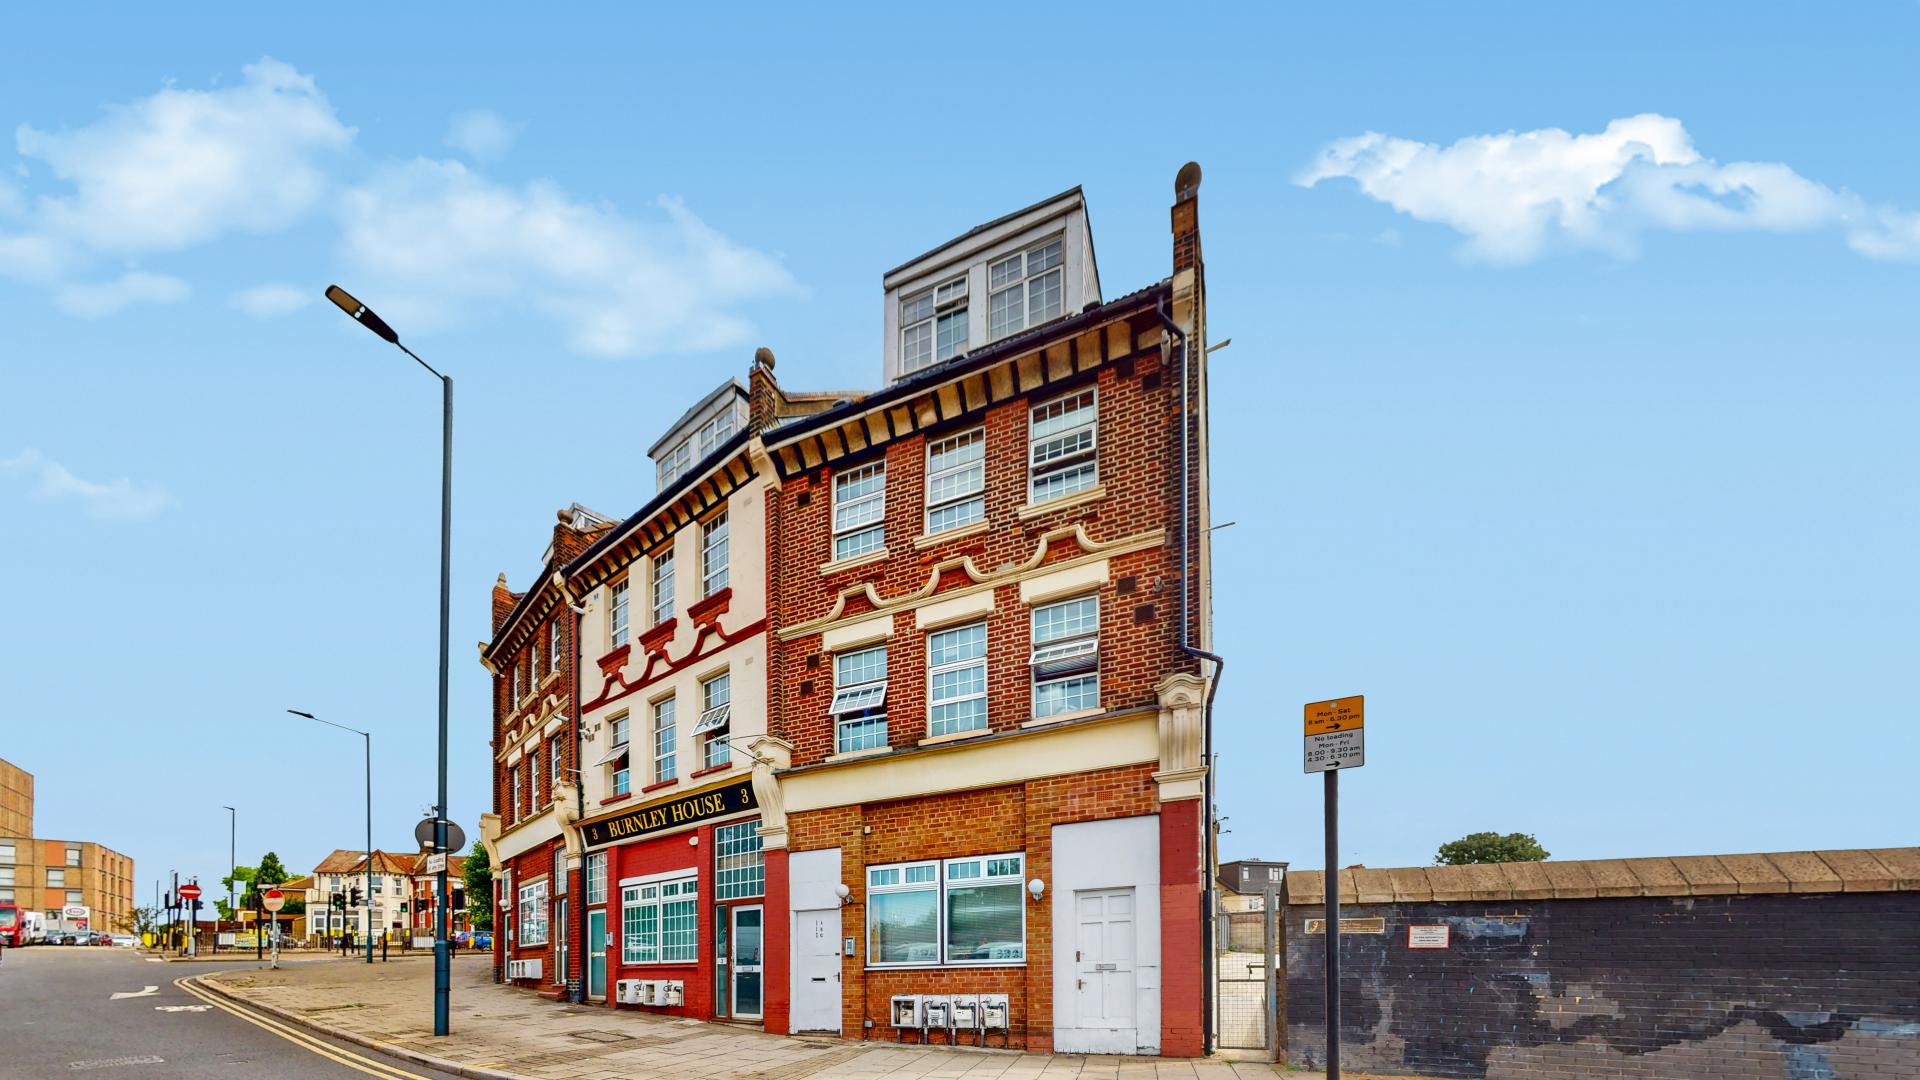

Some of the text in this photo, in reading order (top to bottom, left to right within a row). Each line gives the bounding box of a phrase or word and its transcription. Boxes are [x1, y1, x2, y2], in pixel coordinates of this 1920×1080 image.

[591, 788, 749, 841] 3 BURNLEY HOUSE 3
